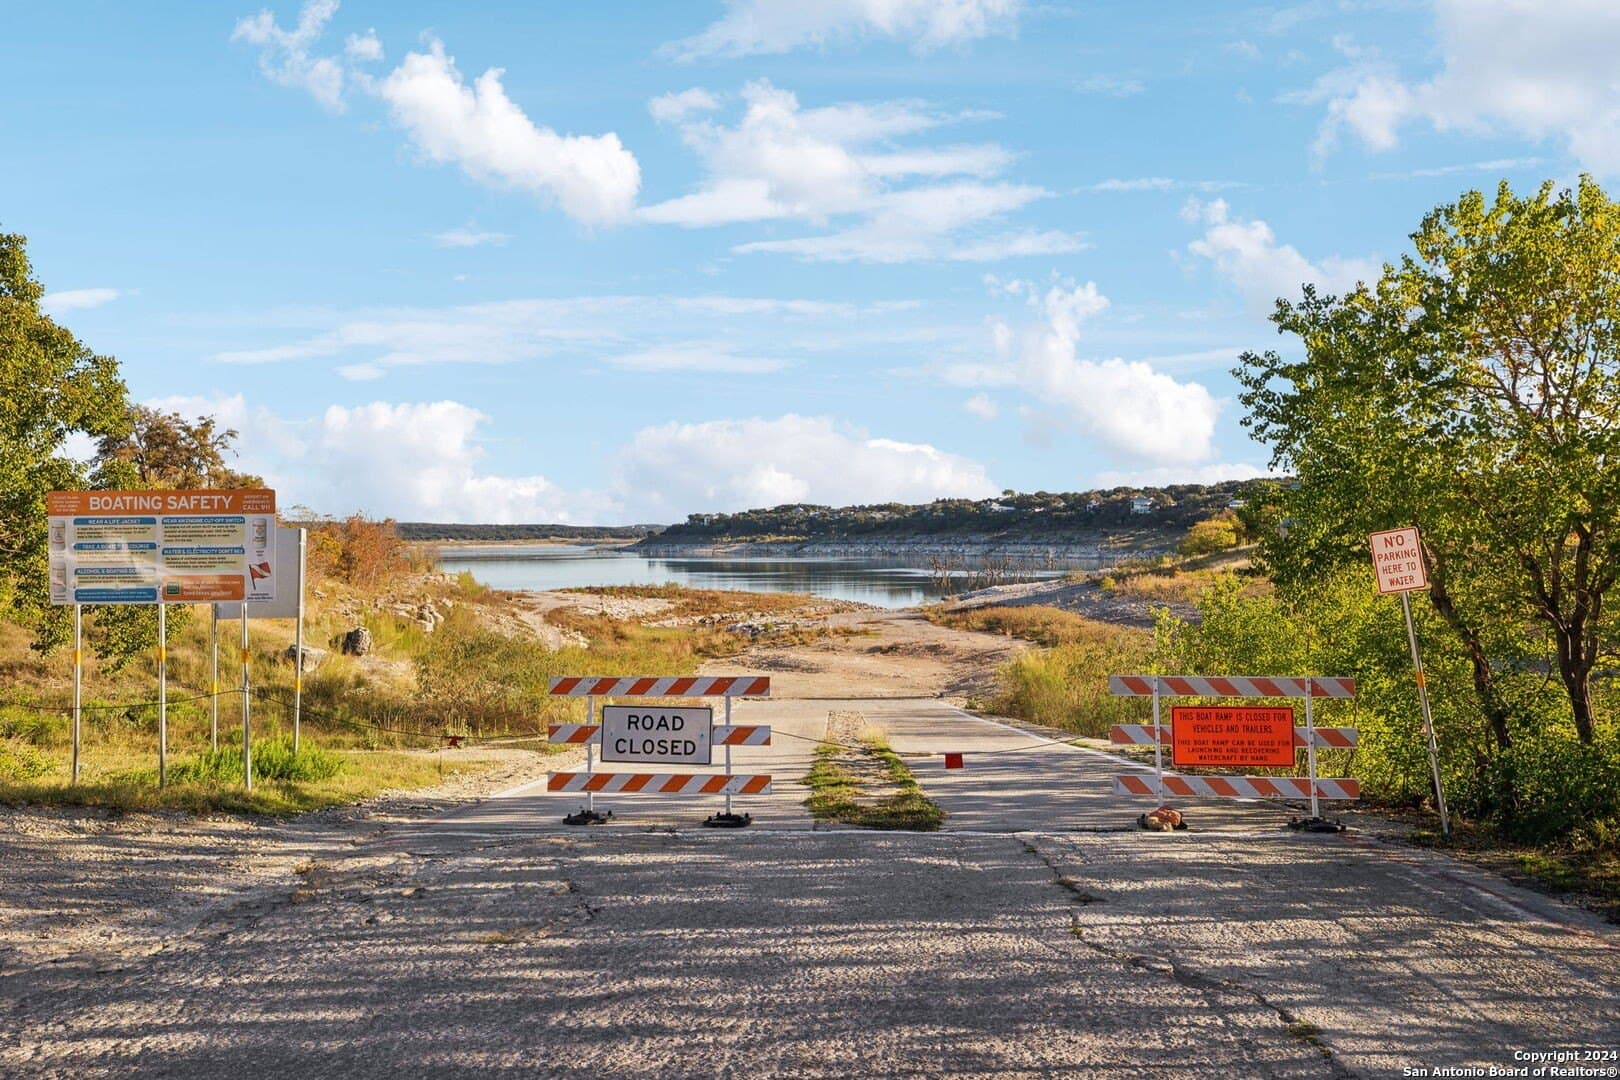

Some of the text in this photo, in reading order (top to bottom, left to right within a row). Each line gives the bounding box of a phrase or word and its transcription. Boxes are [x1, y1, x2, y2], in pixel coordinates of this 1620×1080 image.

[89, 495, 233, 511] BOATING SAFETY
[1384, 535, 1404, 548] NO
[1377, 549, 1416, 561] PARKING
[1382, 562, 1416, 574] HERE TO
[1389, 576, 1415, 586] WATER
[628, 715, 684, 730] ROAD
[1179, 712, 1286, 721] THIS BOAT RAMP IS CLOSED FOR
[1192, 724, 1223, 733] VEHICLES
[1226, 725, 1239, 733] AND
[615, 738, 696, 756] CLOSED
